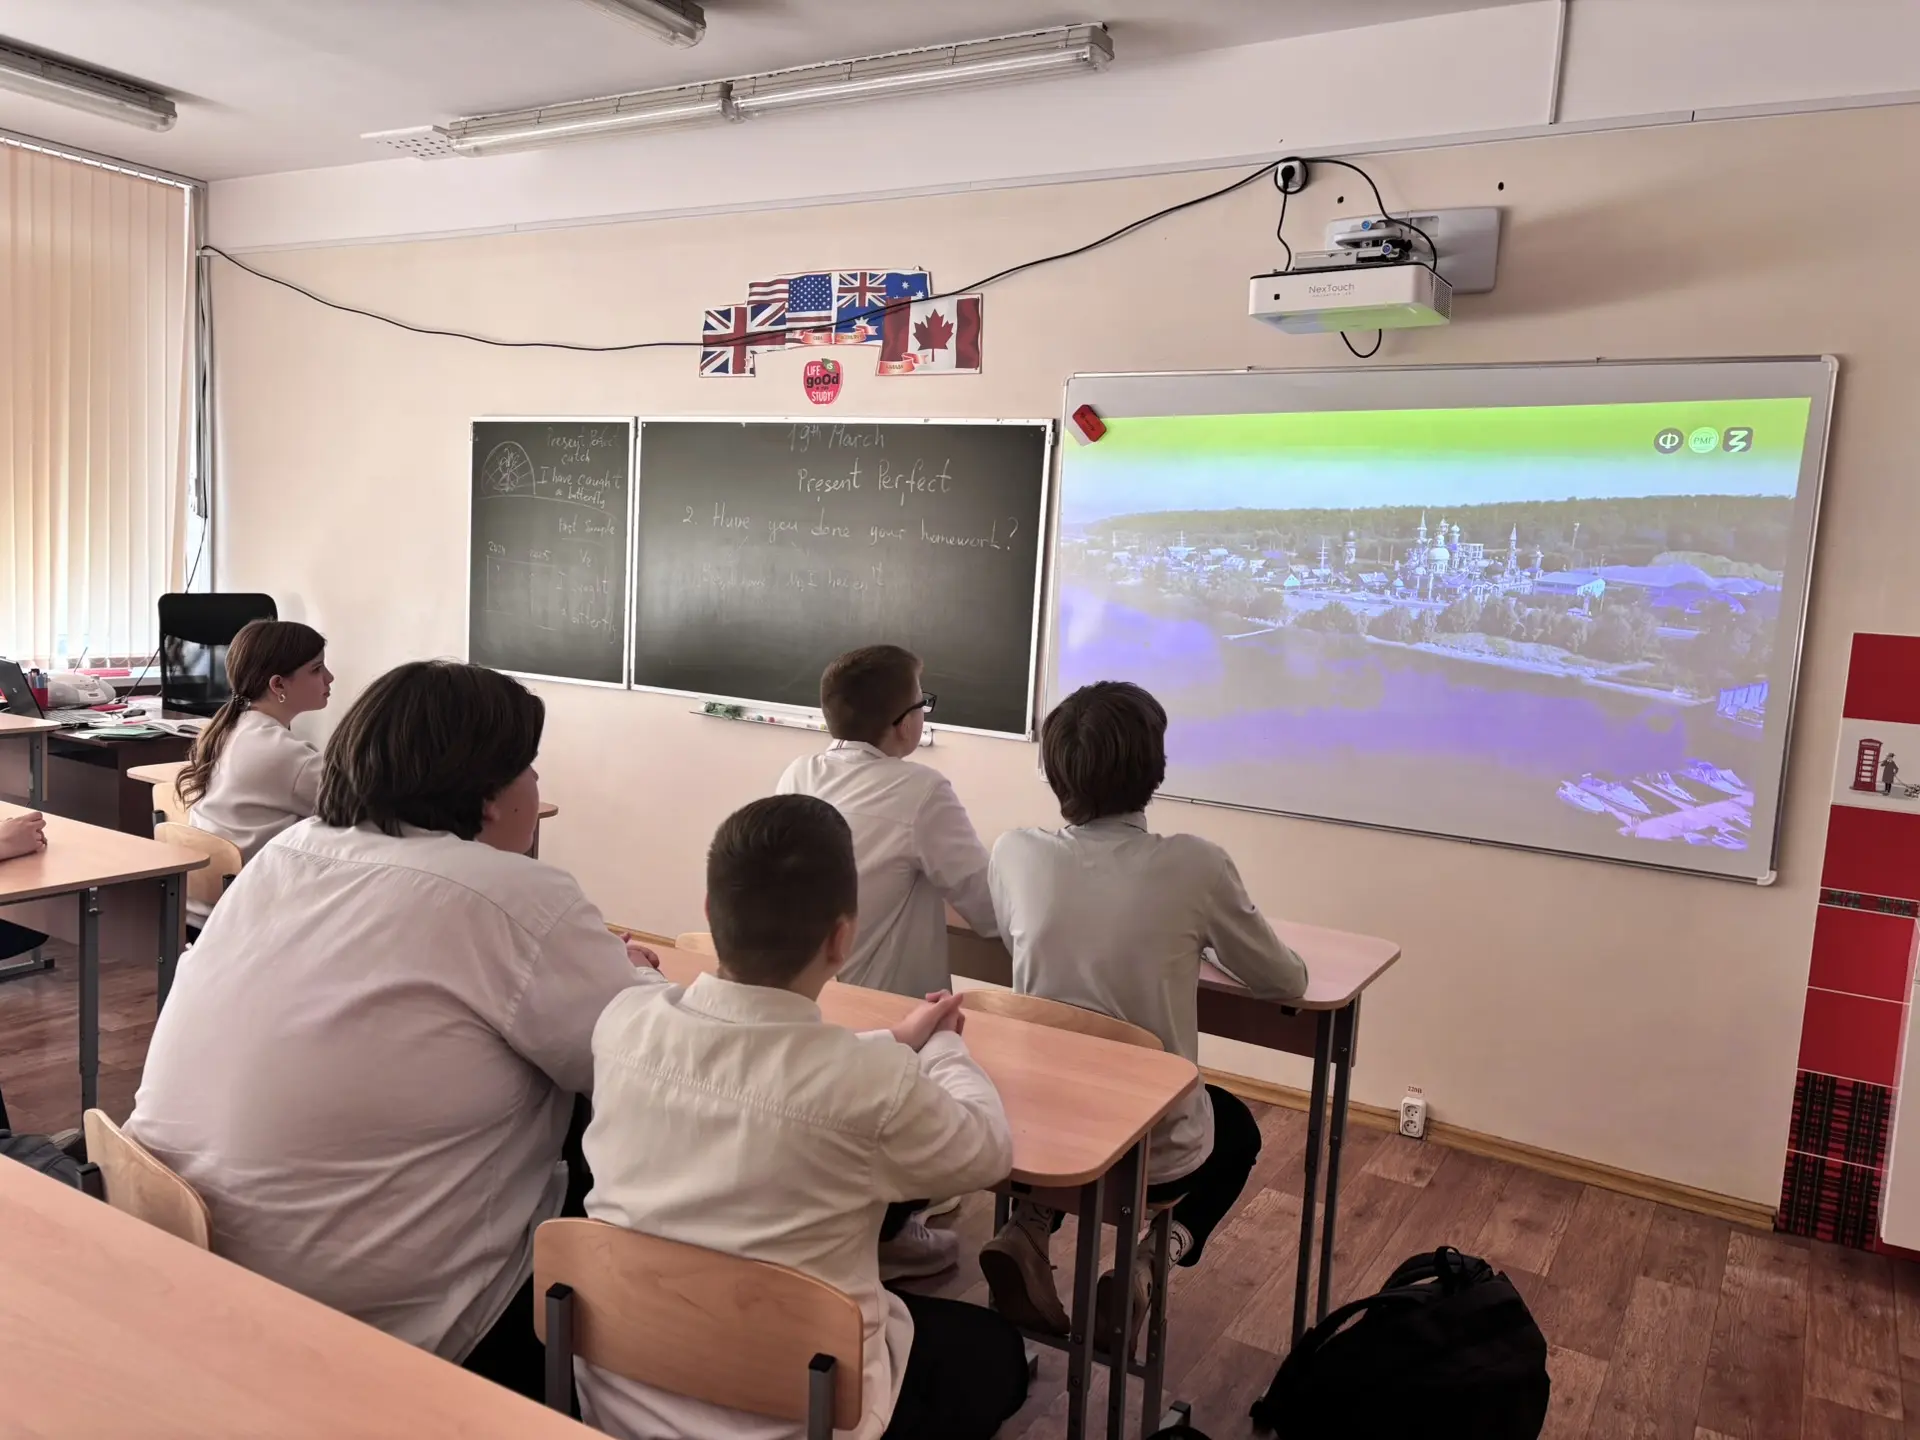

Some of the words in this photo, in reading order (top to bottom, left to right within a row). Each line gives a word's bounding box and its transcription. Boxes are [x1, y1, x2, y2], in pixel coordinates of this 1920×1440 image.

[1308, 283, 1355, 294] NexTouch
[806, 365, 821, 376] LIFE
[811, 390, 834, 402] STUDY!
[829, 424, 884, 449] March
[552, 466, 573, 485] have
[798, 457, 862, 493] Present
[878, 458, 952, 494] Perfect
[712, 502, 751, 530] Have
[768, 518, 799, 544] you
[810, 506, 851, 538] done
[870, 525, 907, 546] your
